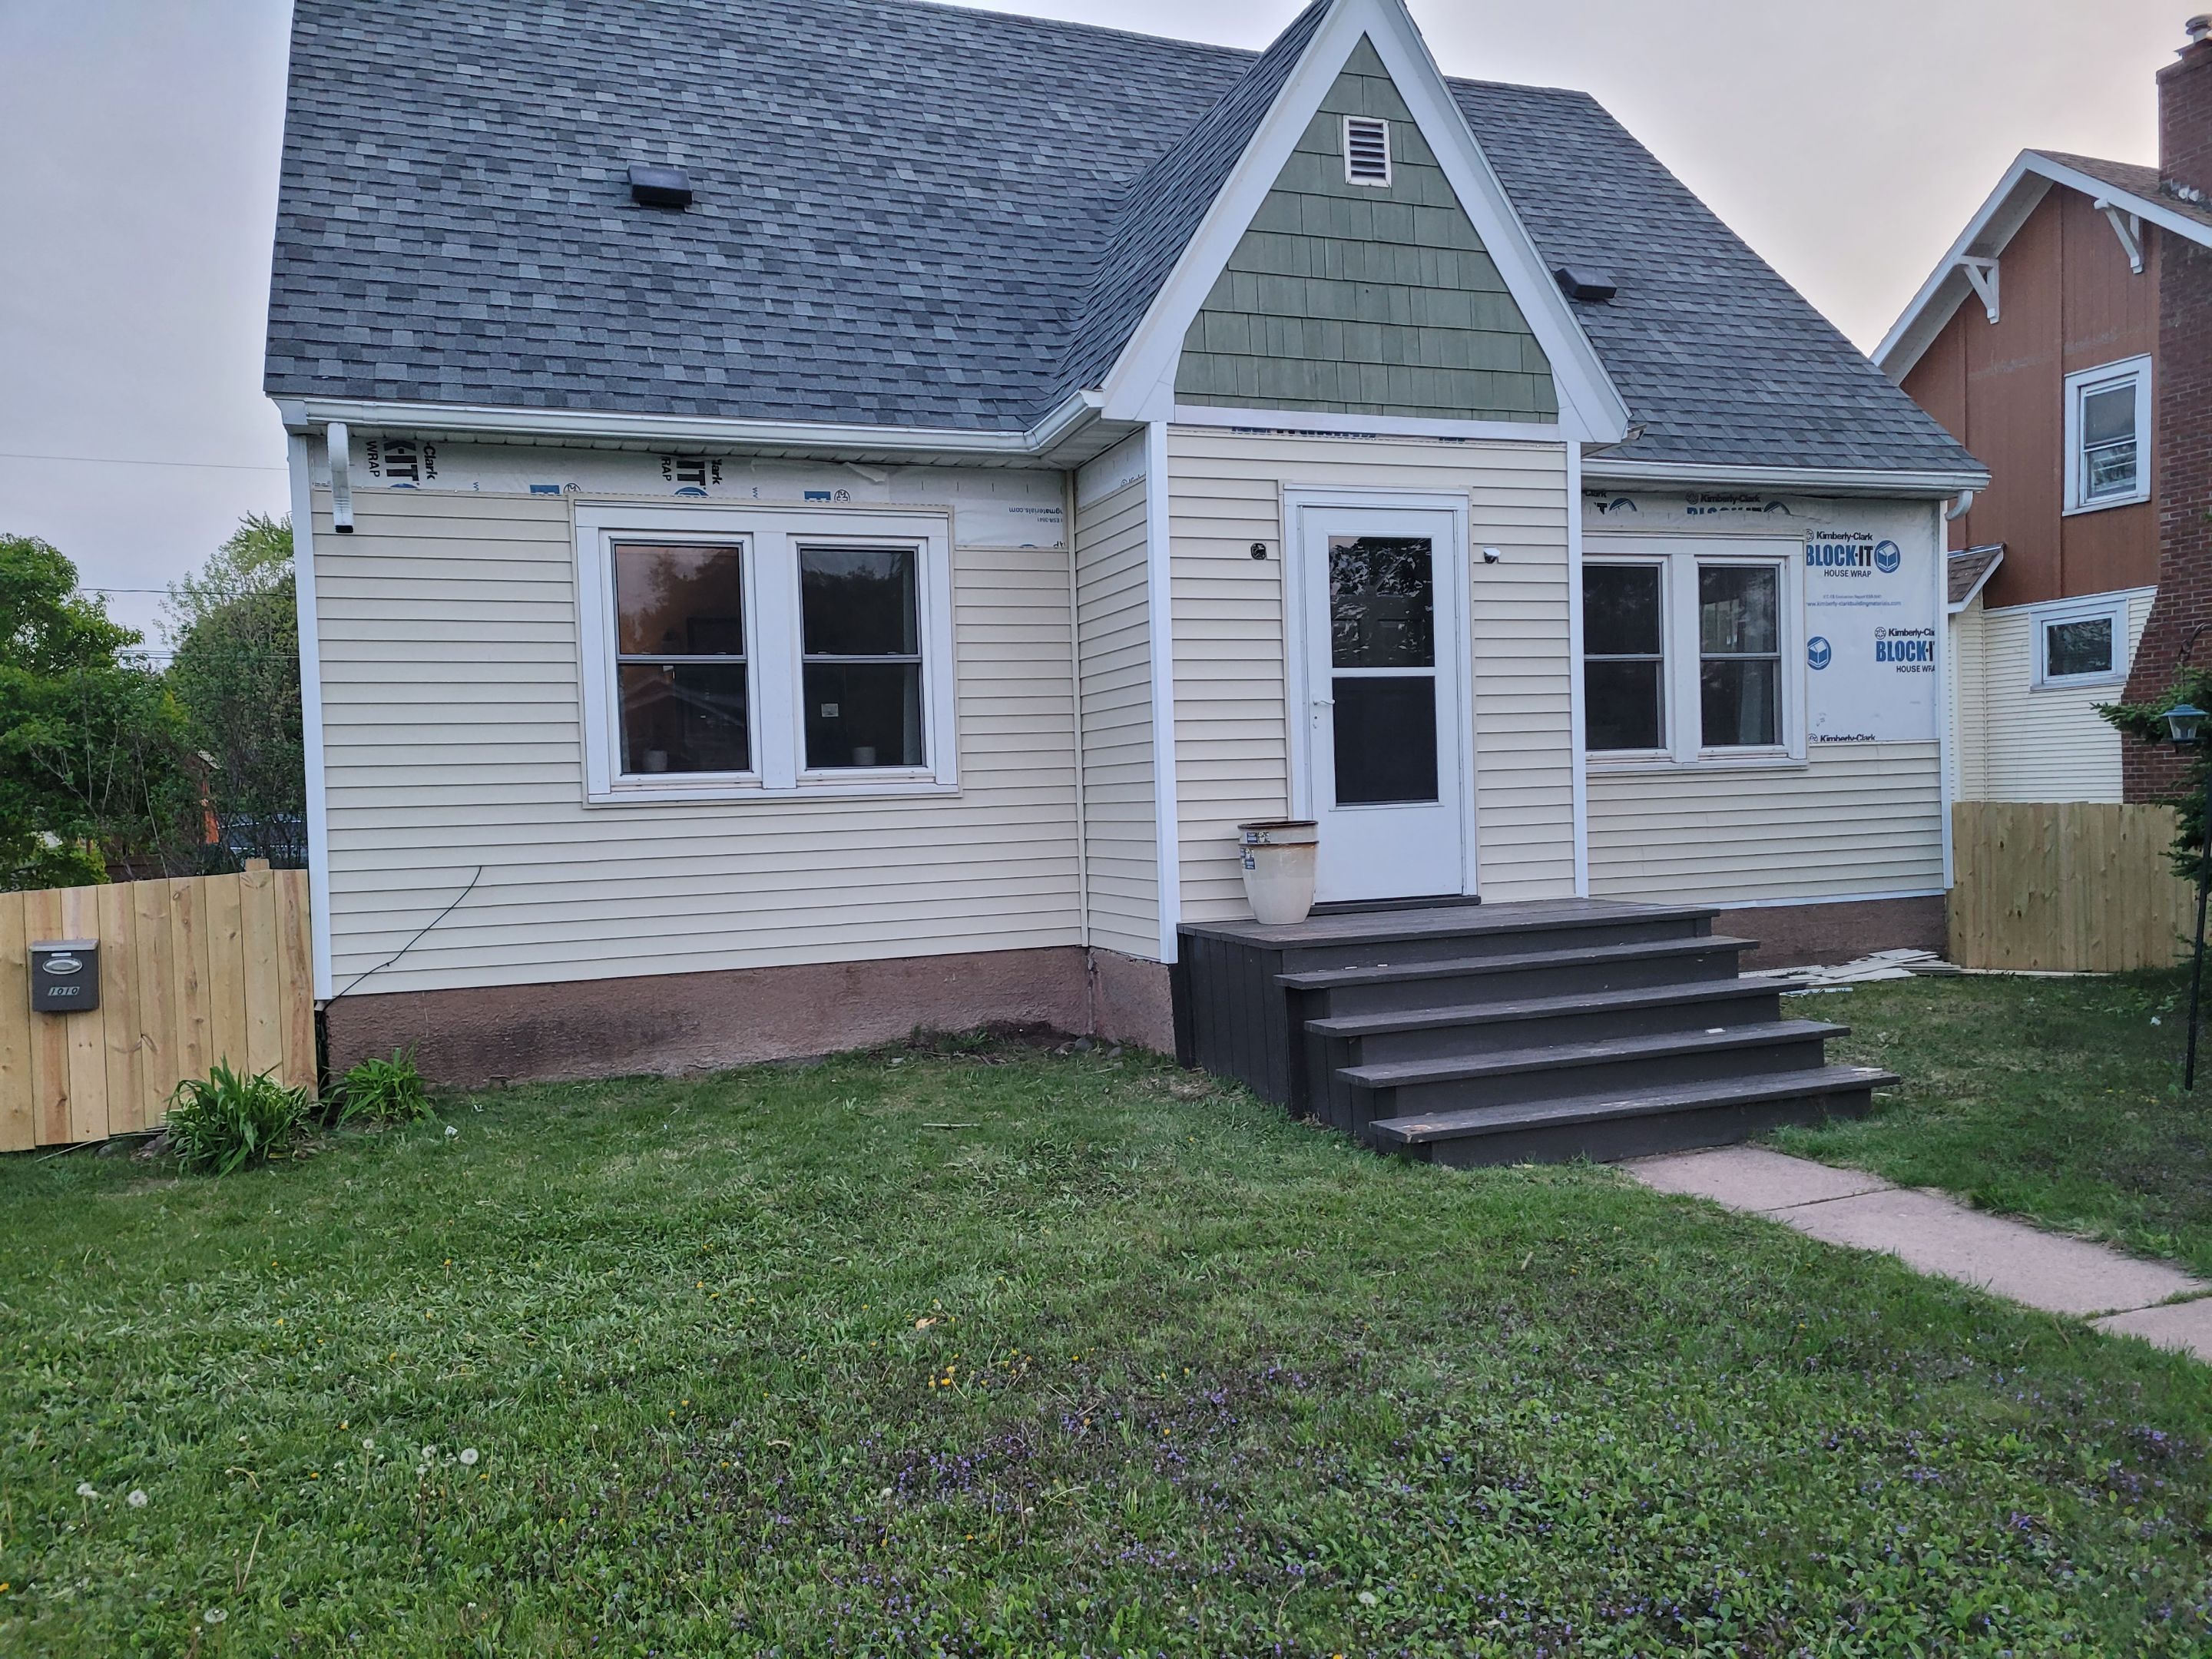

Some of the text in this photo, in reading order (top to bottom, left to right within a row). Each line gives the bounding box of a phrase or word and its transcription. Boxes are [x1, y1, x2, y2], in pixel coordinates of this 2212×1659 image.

[366, 441, 379, 477] WRAP
[661, 456, 672, 482] RAP
[1816, 531, 1873, 542] Kimberly-Clark
[1824, 569, 1849, 578] HOUSE
[51, 987, 78, 995] 1010
